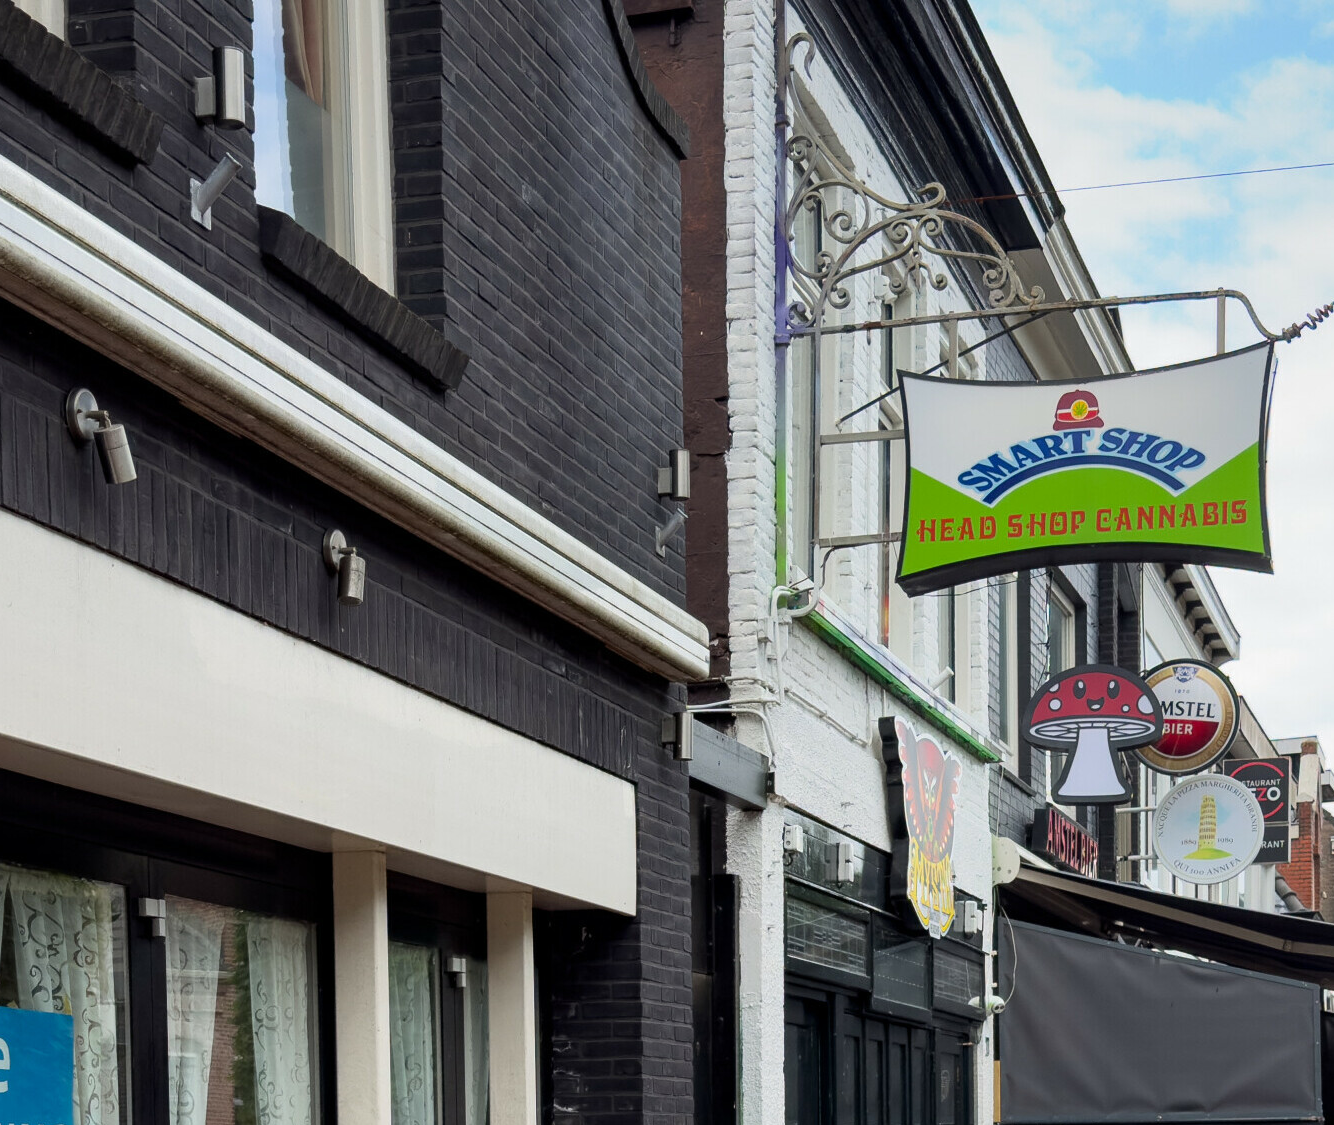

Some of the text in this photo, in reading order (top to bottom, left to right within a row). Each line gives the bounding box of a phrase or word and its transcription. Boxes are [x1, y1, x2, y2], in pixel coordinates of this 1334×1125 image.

[957, 428, 1206, 492] SMART SHOP
[917, 500, 1247, 542] HEAD SHOP CANNABIS
[1161, 700, 1215, 718] MSTEL
[1163, 723, 1193, 735] BIER
[1169, 796, 1178, 806] LA
[1177, 783, 1199, 797] PIZZA
[1201, 780, 1247, 804] MARGHERITA
[1242, 779, 1281, 787] TAURANT
[1046, 807, 1079, 871] AMSTEL
[1173, 859, 1188, 872] QUI
[1207, 864, 1230, 875] ANNI
[1230, 857, 1242, 867] FA
